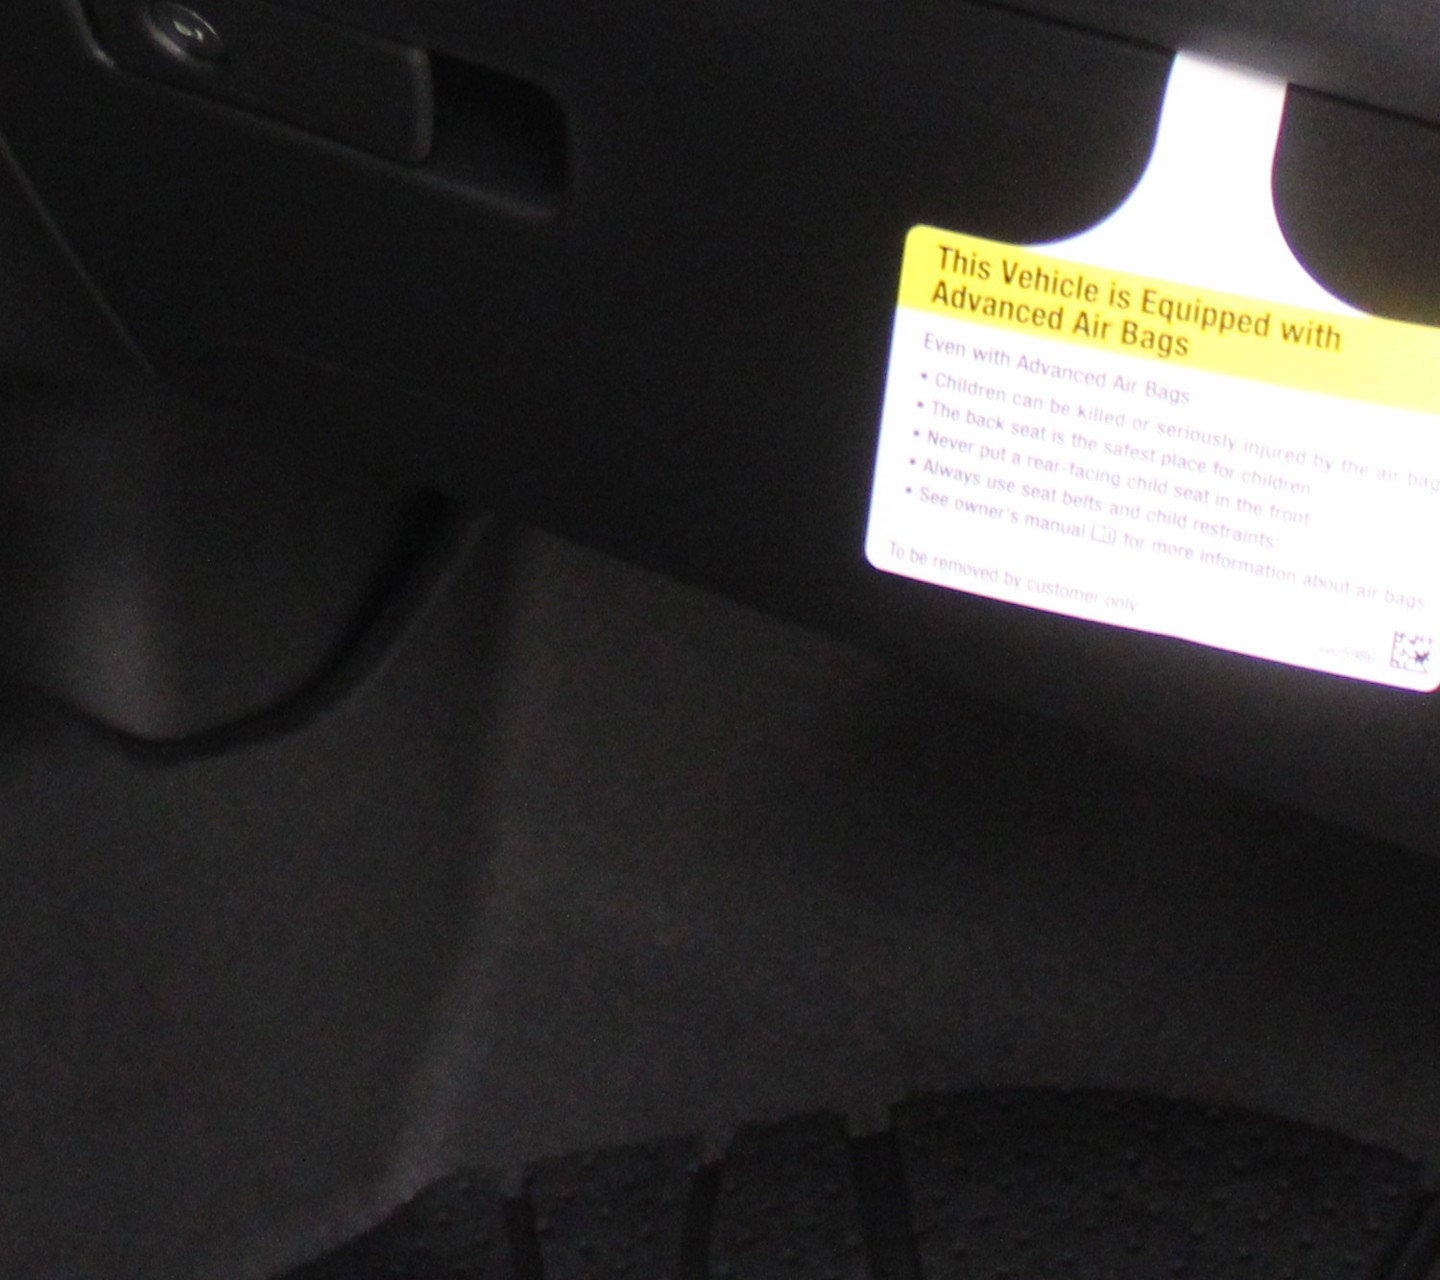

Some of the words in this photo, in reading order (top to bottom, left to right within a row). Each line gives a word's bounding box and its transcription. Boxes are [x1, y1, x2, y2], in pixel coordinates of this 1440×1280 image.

[930, 280, 1065, 331] Advanced
[1071, 309, 1112, 340] Air
[1120, 318, 1190, 359] Bags
[937, 243, 992, 281] This
[1000, 258, 1100, 304] Vehicle
[1107, 281, 1132, 311] is
[1140, 287, 1272, 338] Equipped
[1280, 321, 1342, 351] with
[922, 330, 967, 358] Even
[971, 346, 1012, 367] with
[1015, 352, 1108, 389] Advanced
[1111, 373, 1139, 394] Air
[1144, 378, 1191, 407] Bags
[931, 398, 962, 423] The
[964, 408, 1006, 432] back
[1010, 421, 1048, 442] seat
[1050, 428, 1066, 447] is
[1070, 431, 1099, 452] the
[1102, 441, 1157, 464] safest
[1159, 451, 1208, 474] place
[1211, 459, 1236, 480] for
[933, 370, 1007, 403] Children
[1011, 392, 1044, 410] can
[1048, 396, 1072, 417] be
[1075, 403, 1127, 428] killed
[1130, 416, 1151, 432] or
[1155, 421, 1238, 454] seriously
[1242, 439, 1309, 466] injured
[1312, 451, 1334, 474] by
[1340, 458, 1370, 477] the
[1375, 467, 1400, 482] air
[922, 456, 982, 487] Always
[985, 476, 1017, 494] use
[1020, 483, 1058, 504] seat
[1061, 489, 1104, 513] belts
[1108, 501, 1142, 520] and
[1145, 508, 1189, 530] child
[926, 428, 975, 453] Never
[978, 444, 1008, 463] put
[1010, 451, 1022, 466] a
[1025, 454, 1122, 490] rear-facing
[1125, 474, 1170, 496] child
[1172, 484, 1211, 505] seat
[1214, 492, 1231, 509] in
[1235, 496, 1264, 517] the
[888, 538, 906, 561] To
[908, 546, 929, 566] be
[931, 555, 1000, 584] removed
[1002, 569, 1023, 590] by
[1025, 577, 1100, 605] customer
[918, 485, 950, 508] See
[953, 497, 1020, 524] owner's
[1023, 512, 1087, 538] manual
[1122, 531, 1146, 550] for
[1150, 539, 1196, 561] more
[1198, 548, 1297, 583] information
[1301, 572, 1352, 595] about
[1355, 584, 1379, 600] air
